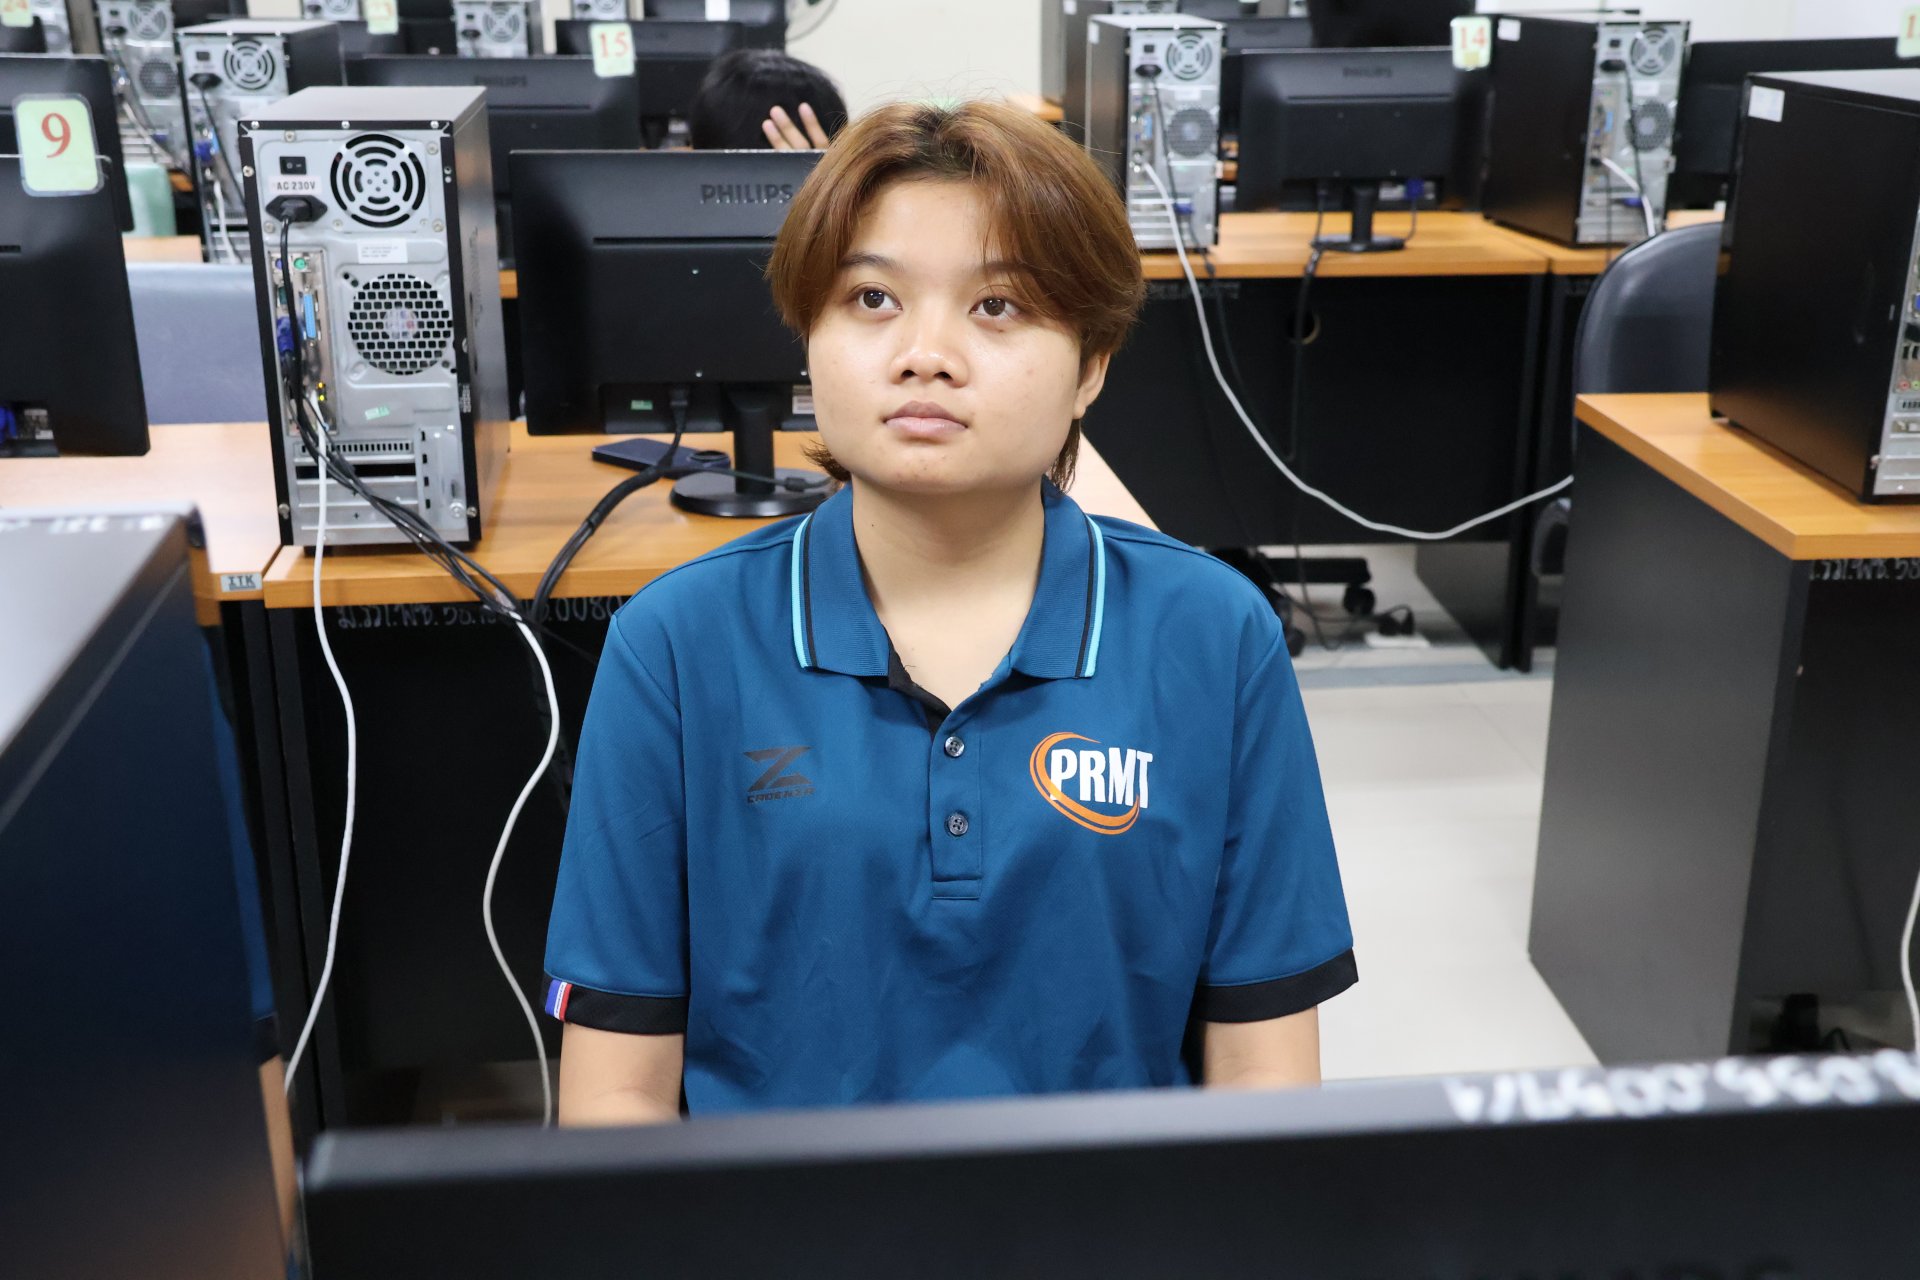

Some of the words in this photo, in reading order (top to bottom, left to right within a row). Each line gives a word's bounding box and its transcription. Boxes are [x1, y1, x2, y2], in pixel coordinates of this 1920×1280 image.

[599, 31, 628, 60] 15
[1460, 26, 1487, 49] 14
[41, 112, 71, 159] 9
[276, 181, 290, 191] AC
[292, 180, 316, 190] 230V
[700, 183, 793, 205] PHILIPS
[228, 574, 256, 588] ITK
[1049, 747, 1154, 809] PRMT
